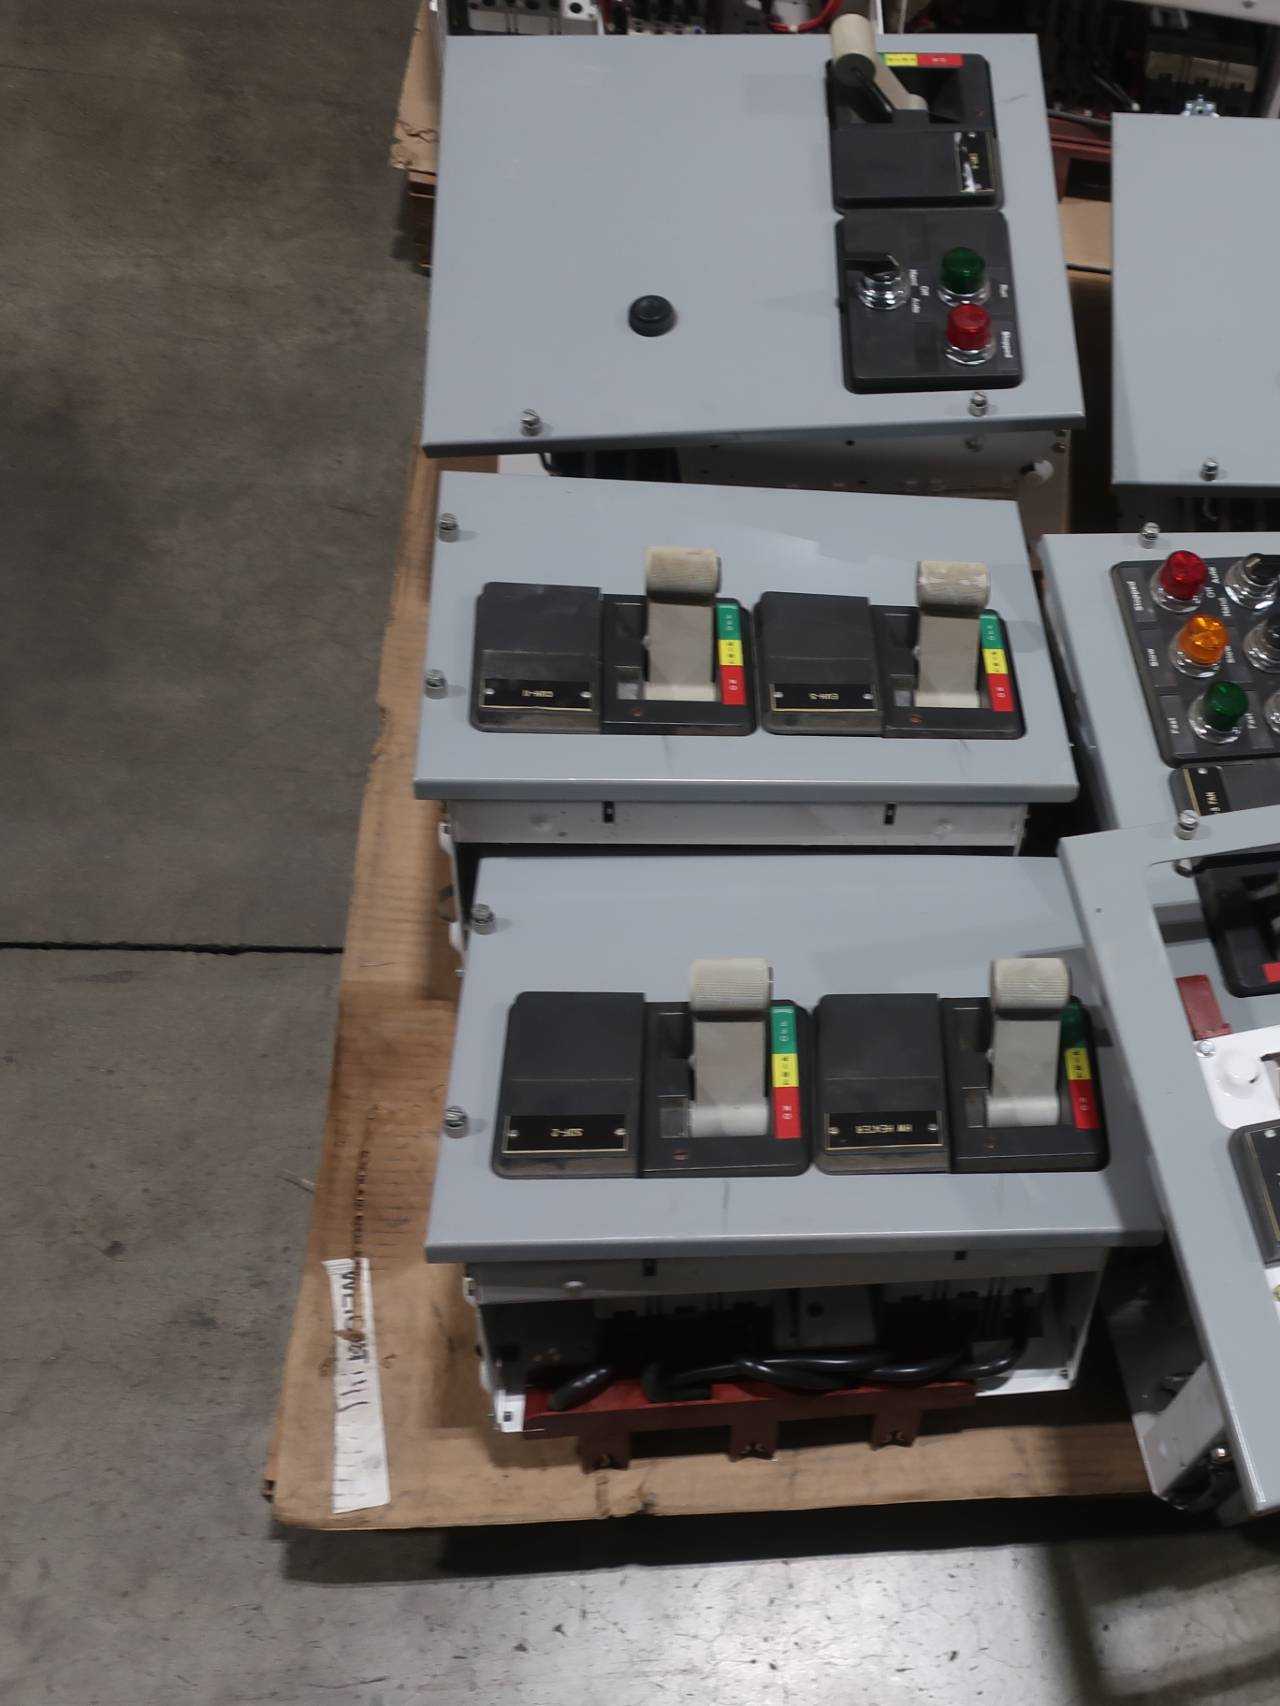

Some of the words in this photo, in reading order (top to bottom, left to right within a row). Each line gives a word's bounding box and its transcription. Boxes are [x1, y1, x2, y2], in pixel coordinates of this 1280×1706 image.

[1207, 566, 1221, 584] Auto
[1126, 580, 1144, 611] Stopped
[1203, 586, 1216, 598] Off
[1218, 597, 1232, 616] Hand
